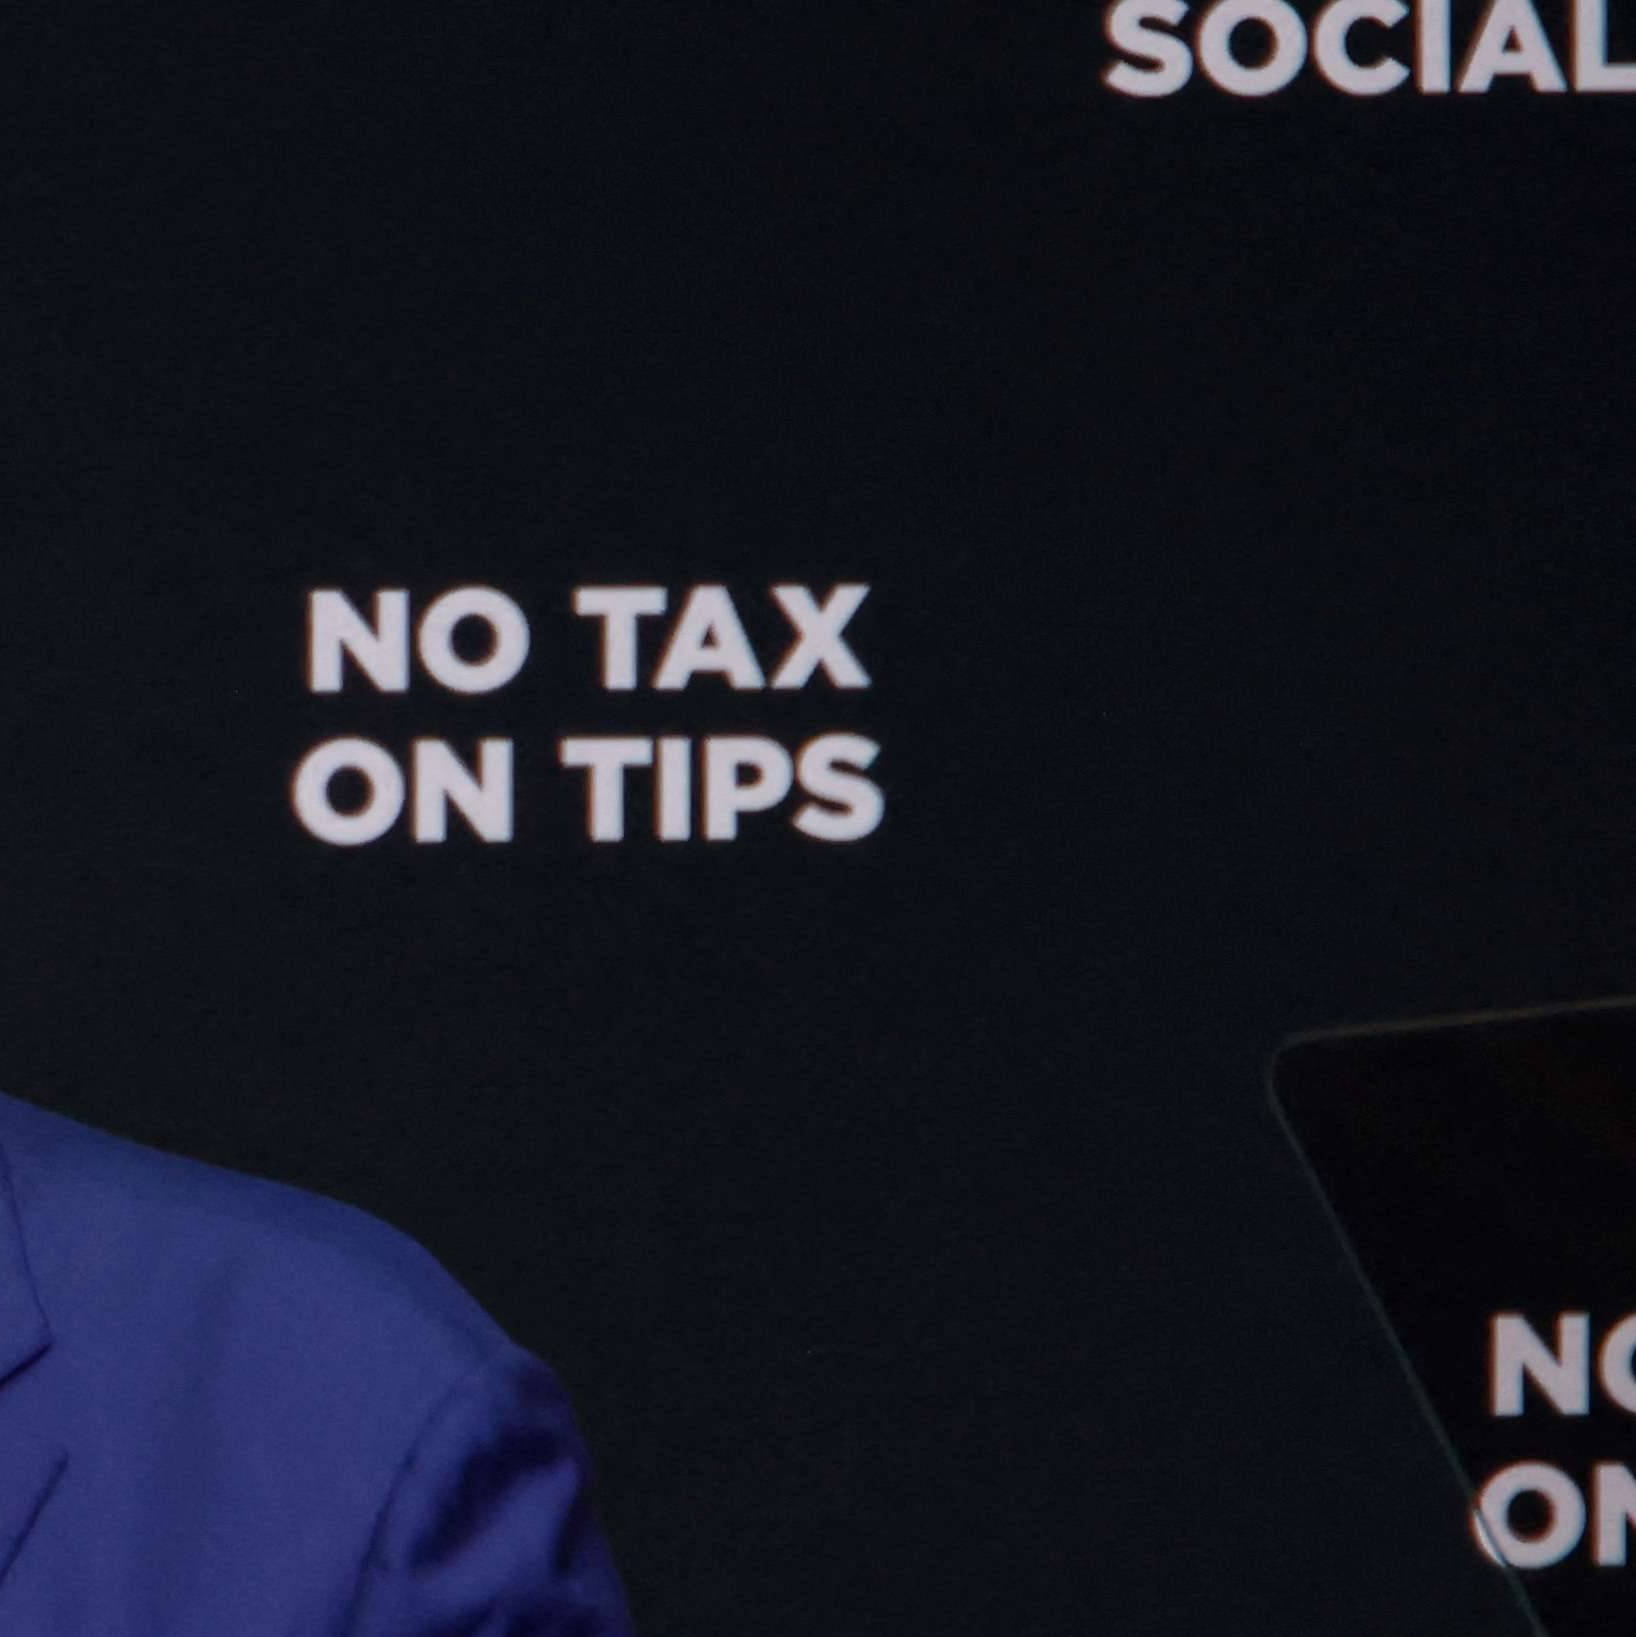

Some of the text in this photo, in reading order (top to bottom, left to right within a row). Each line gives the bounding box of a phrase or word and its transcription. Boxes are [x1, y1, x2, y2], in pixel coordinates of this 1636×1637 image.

[1104, 0, 1636, 98] SOCIAL
[307, 583, 870, 695] NO TAX
[292, 732, 885, 847] ON TIPS
